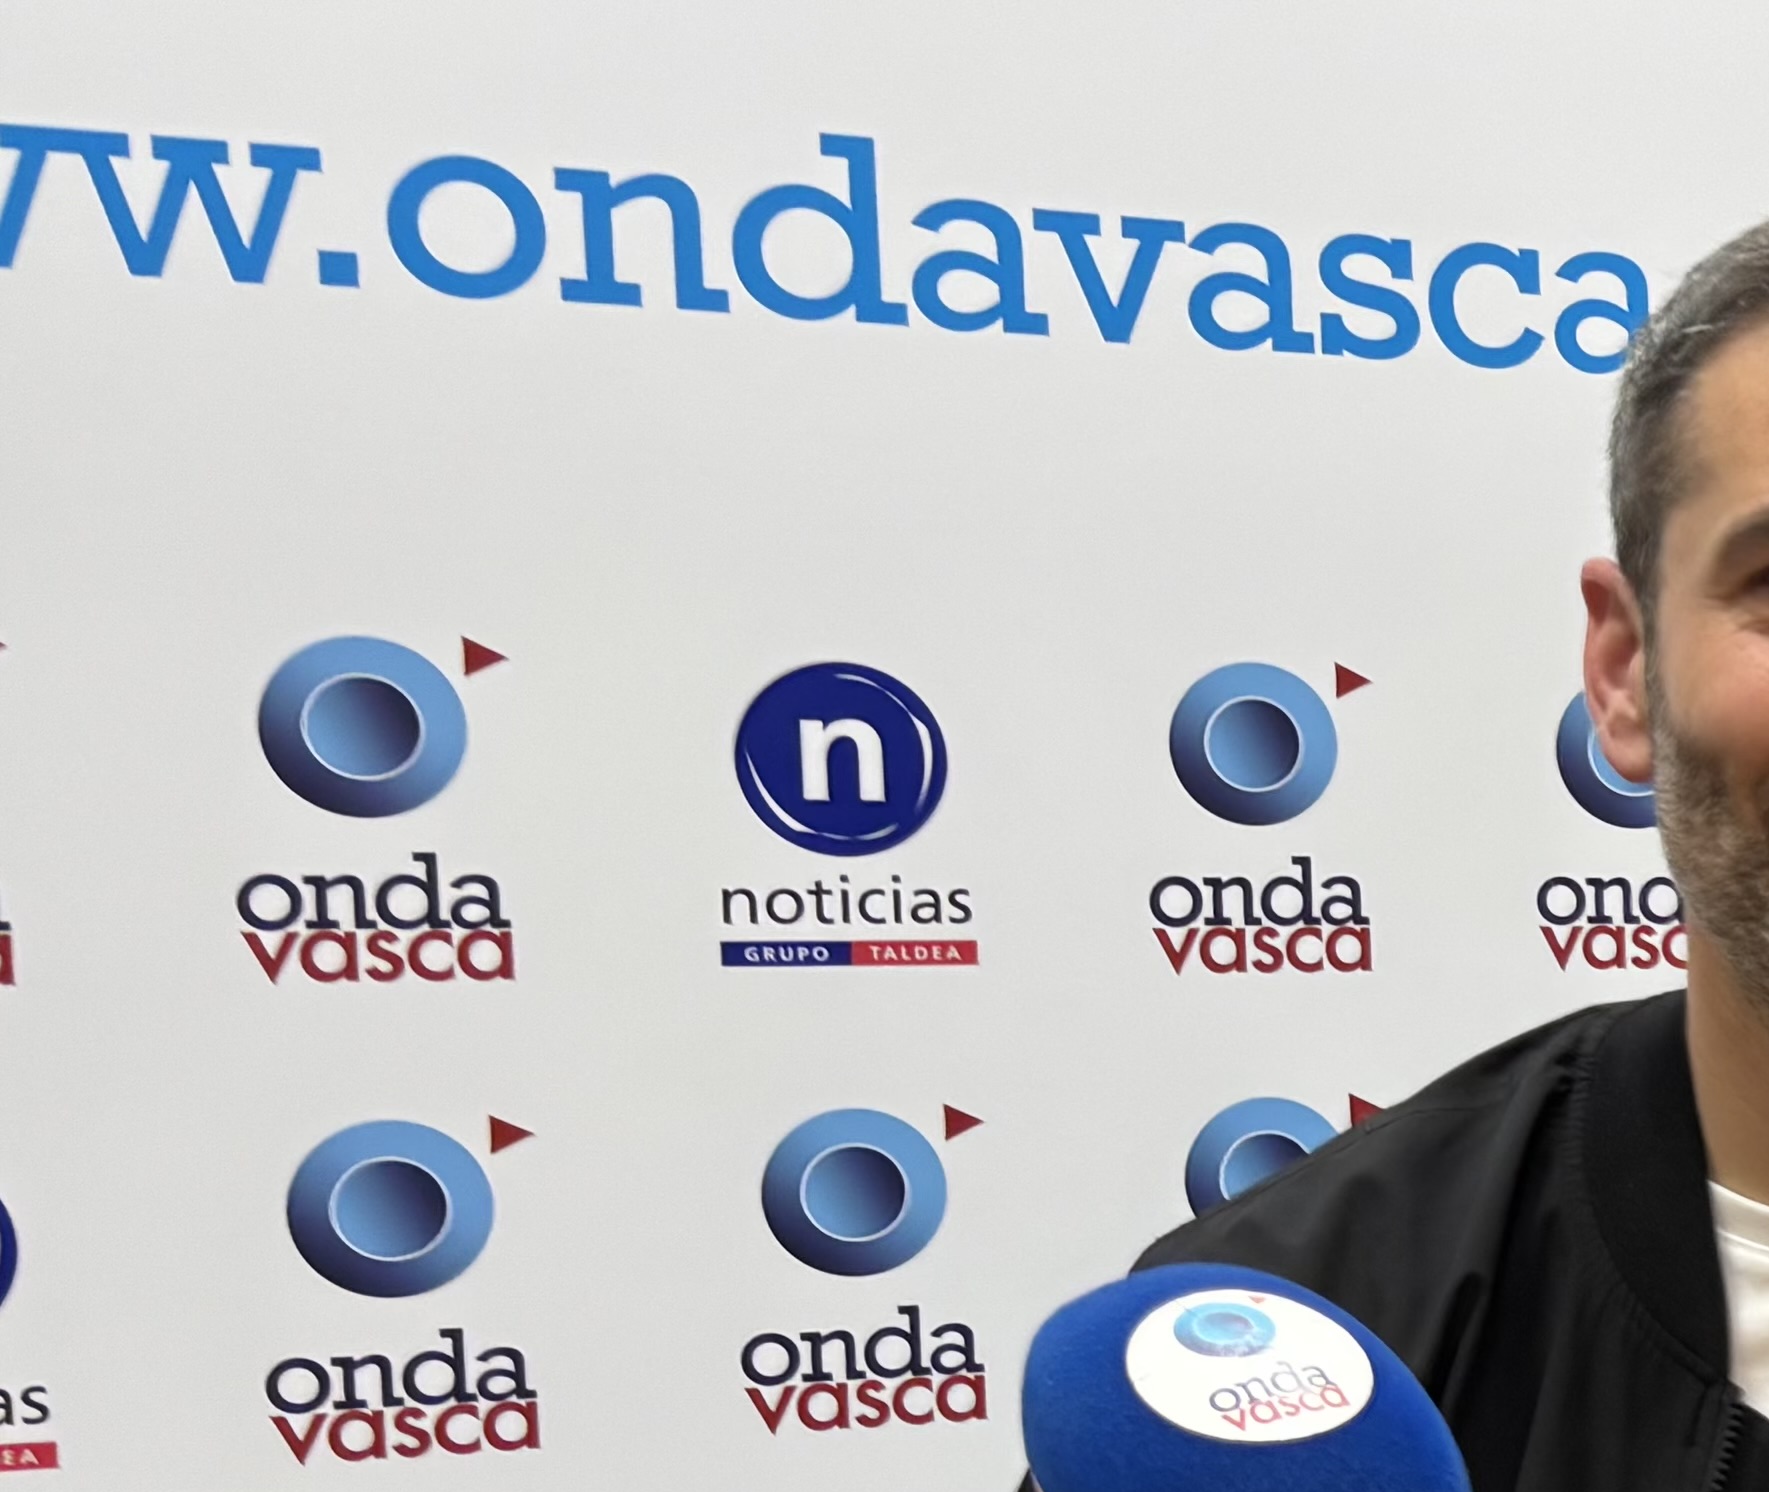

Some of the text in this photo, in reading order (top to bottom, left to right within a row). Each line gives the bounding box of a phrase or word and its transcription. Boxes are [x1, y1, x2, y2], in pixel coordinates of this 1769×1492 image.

[0, 123, 1649, 374] w.ondavasca
[799, 718, 886, 802] n
[236, 851, 511, 931] onda
[721, 874, 973, 925] noticias
[1149, 856, 1370, 927] onda
[240, 929, 516, 985] vasca
[743, 944, 962, 963] GRUPO TALDEA
[1152, 925, 1373, 976] vasca
[1539, 925, 1689, 972] vasc
[265, 1328, 537, 1414] onda
[741, 1305, 985, 1386] onda
[744, 1372, 988, 1435] vasca
[1209, 1361, 1337, 1412] onda
[1221, 1384, 1350, 1431] vasca
[269, 1400, 541, 1467] vasca
